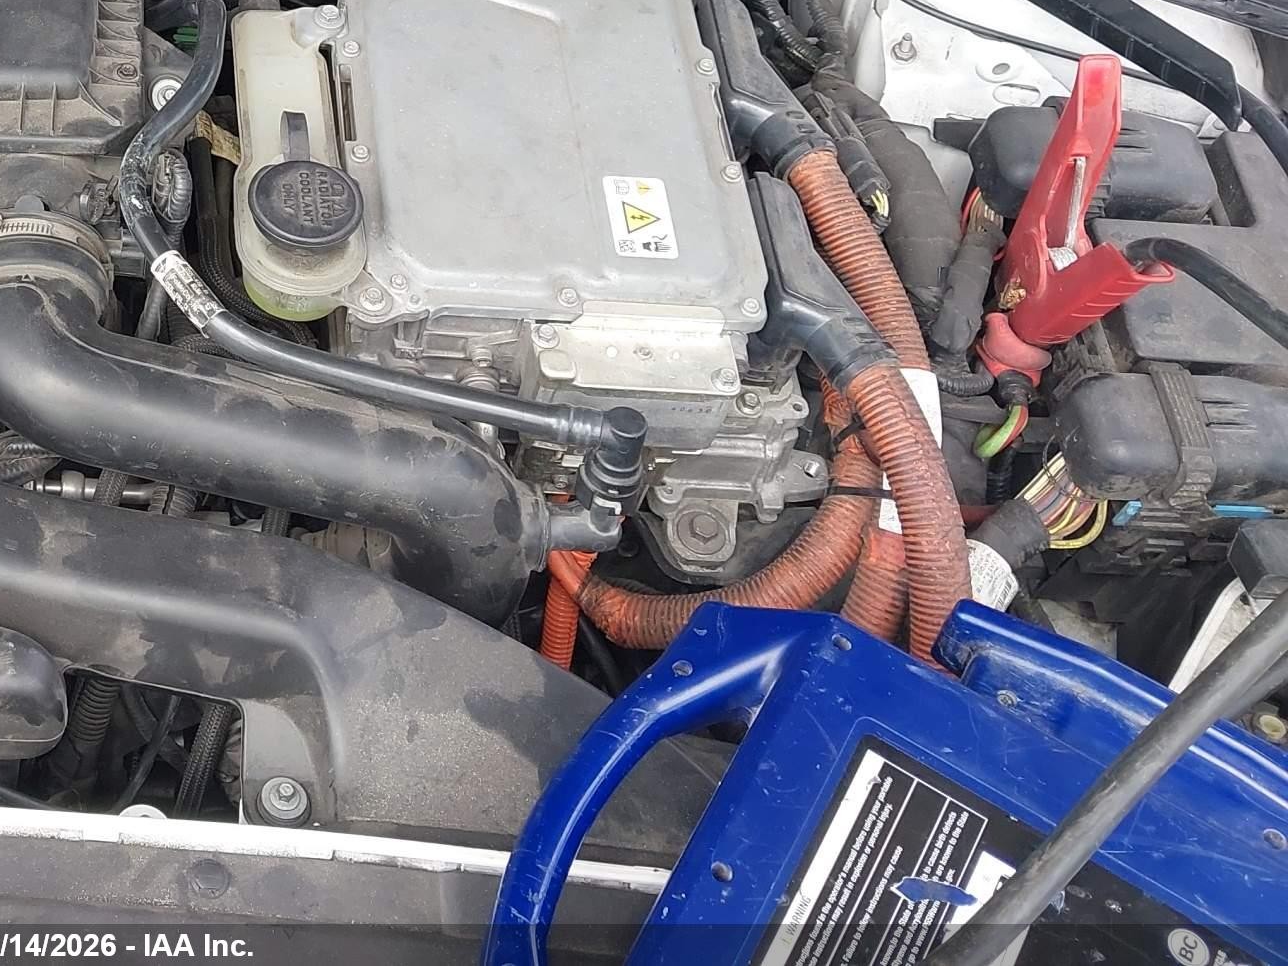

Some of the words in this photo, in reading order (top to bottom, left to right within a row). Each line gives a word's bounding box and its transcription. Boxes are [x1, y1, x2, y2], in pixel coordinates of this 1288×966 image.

[878, 776, 893, 802] portable
[872, 800, 882, 816] your
[864, 814, 875, 832] using
[958, 811, 969, 828] State
[854, 830, 866, 850] before
[950, 837, 957, 845] to
[953, 826, 961, 838] the
[842, 849, 857, 873] manual
[940, 844, 953, 866] known
[895, 926, 903, 938] the
[900, 909, 911, 926] State
[925, 865, 931, 874] to
[929, 848, 940, 867] cause
[936, 833, 946, 849] birth
[943, 811, 957, 834] defects
[936, 864, 944, 876] are
[814, 920, 835, 958] instructions
[833, 906, 843, 922] may
[839, 887, 851, 907] result
[848, 881, 854, 889] in
[851, 853, 868, 883] explosion
[865, 847, 871, 855] or
[868, 820, 884, 848] personal
[828, 871, 847, 904] operator's
[822, 902, 831, 914] the
[844, 939, 858, 962] Failure
[855, 932, 861, 940] to
[858, 912, 871, 933] follow
[867, 877, 887, 914] instructions
[885, 864, 895, 879] may
[891, 845, 903, 865] cause
[819, 912, 826, 921] in
[810, 919, 822, 939] found
[904, 931, 913, 945] and
[912, 946, 919, 954] to
[1178, 936, 1198, 962] BC
